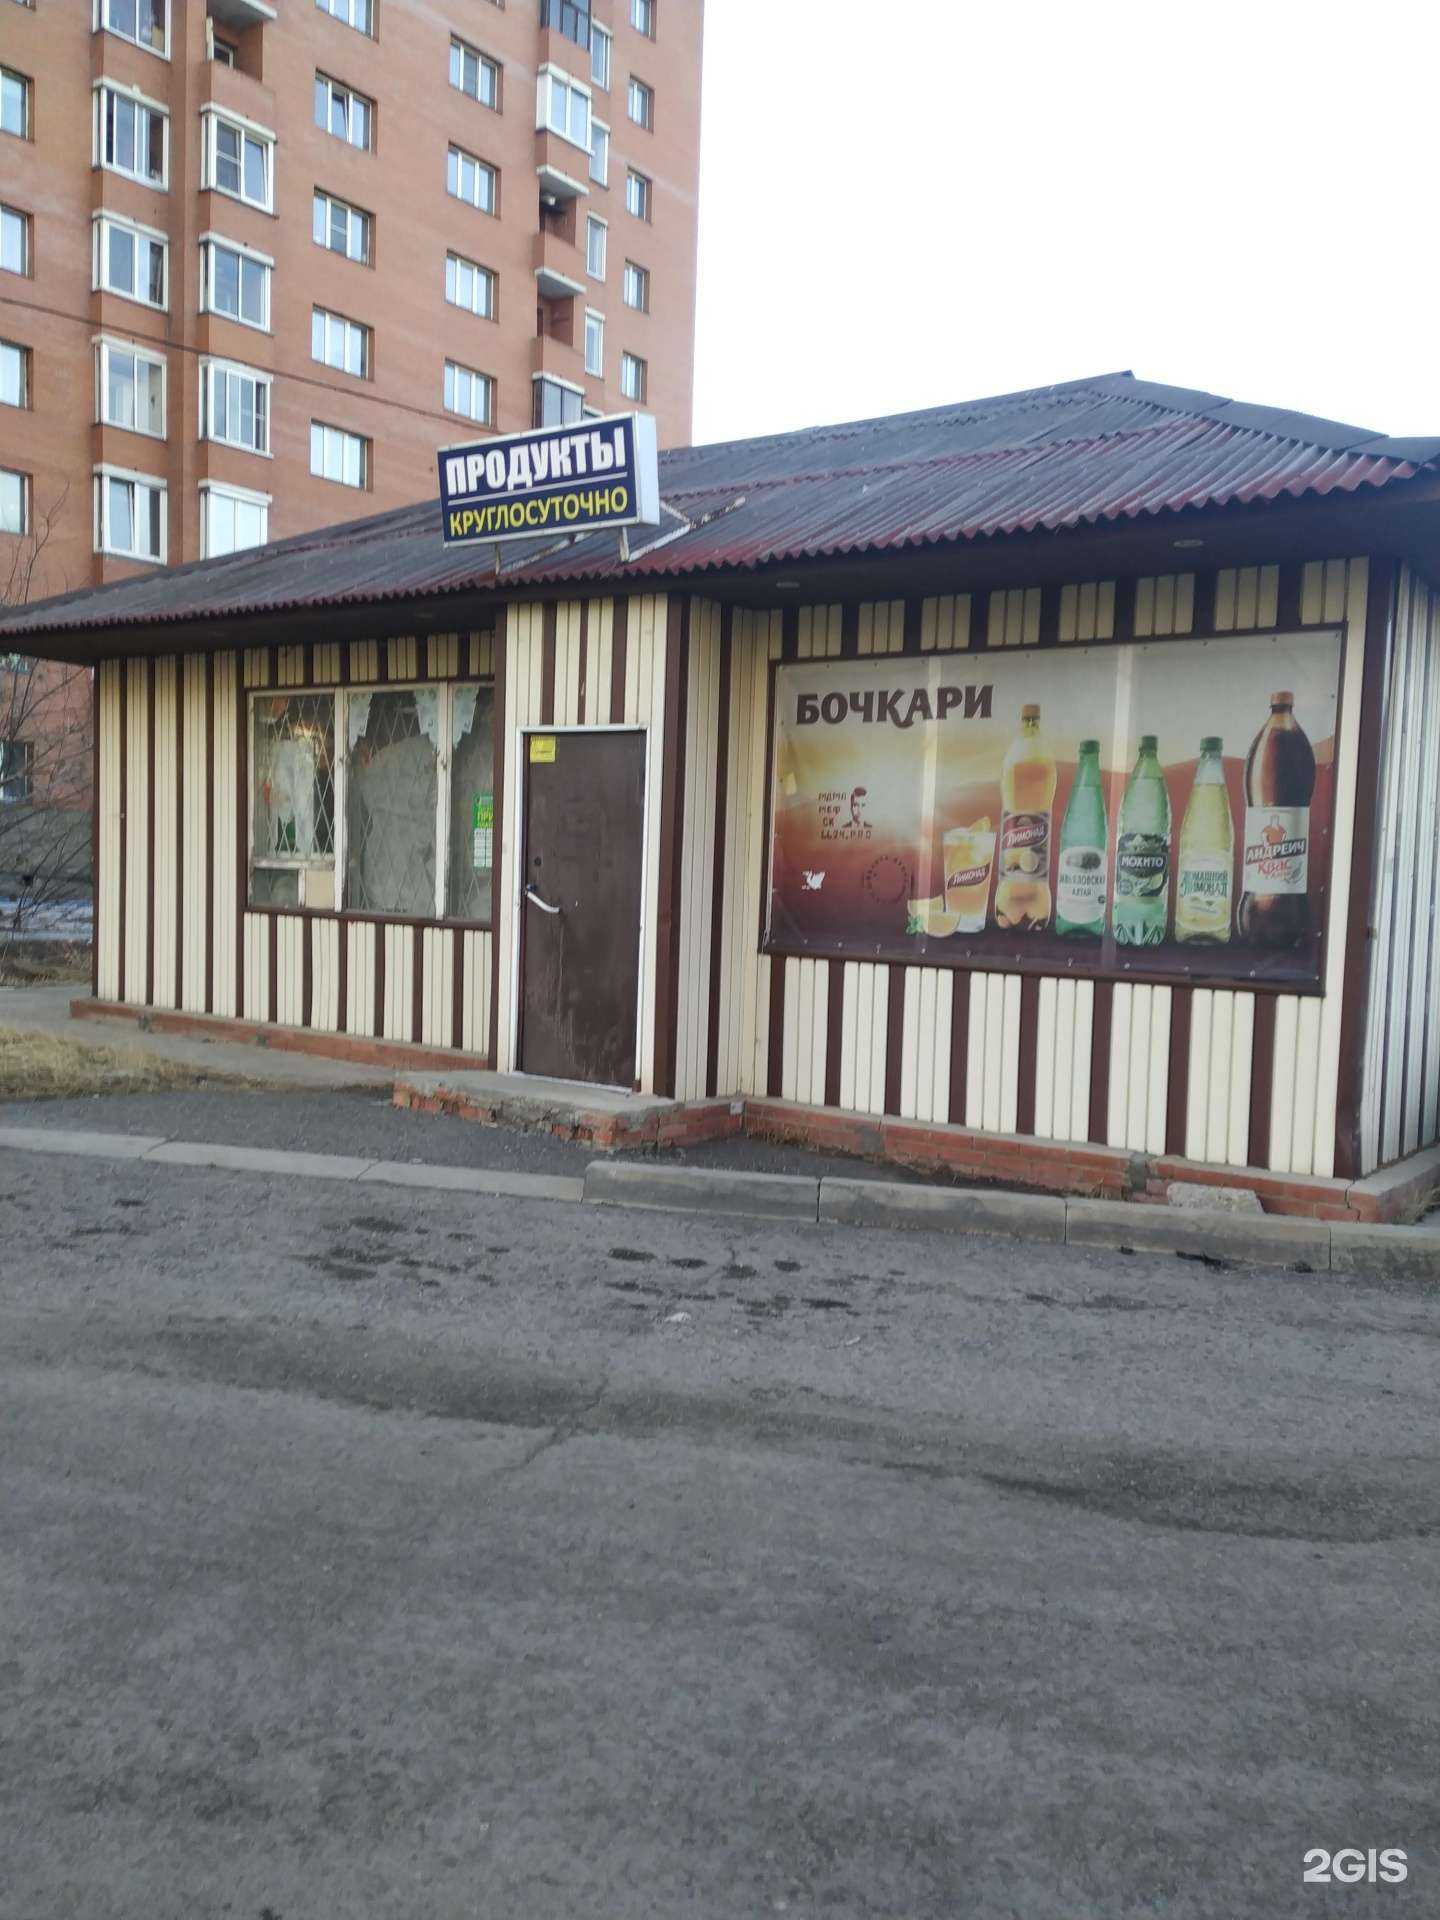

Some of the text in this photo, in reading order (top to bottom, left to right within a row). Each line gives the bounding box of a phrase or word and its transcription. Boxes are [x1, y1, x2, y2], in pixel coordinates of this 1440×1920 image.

[446, 426, 626, 495] ПРОДУКТЫ
[450, 486, 628, 536] КРУГЛОСУТОЧНО
[797, 684, 993, 729] БОЧКАРИ
